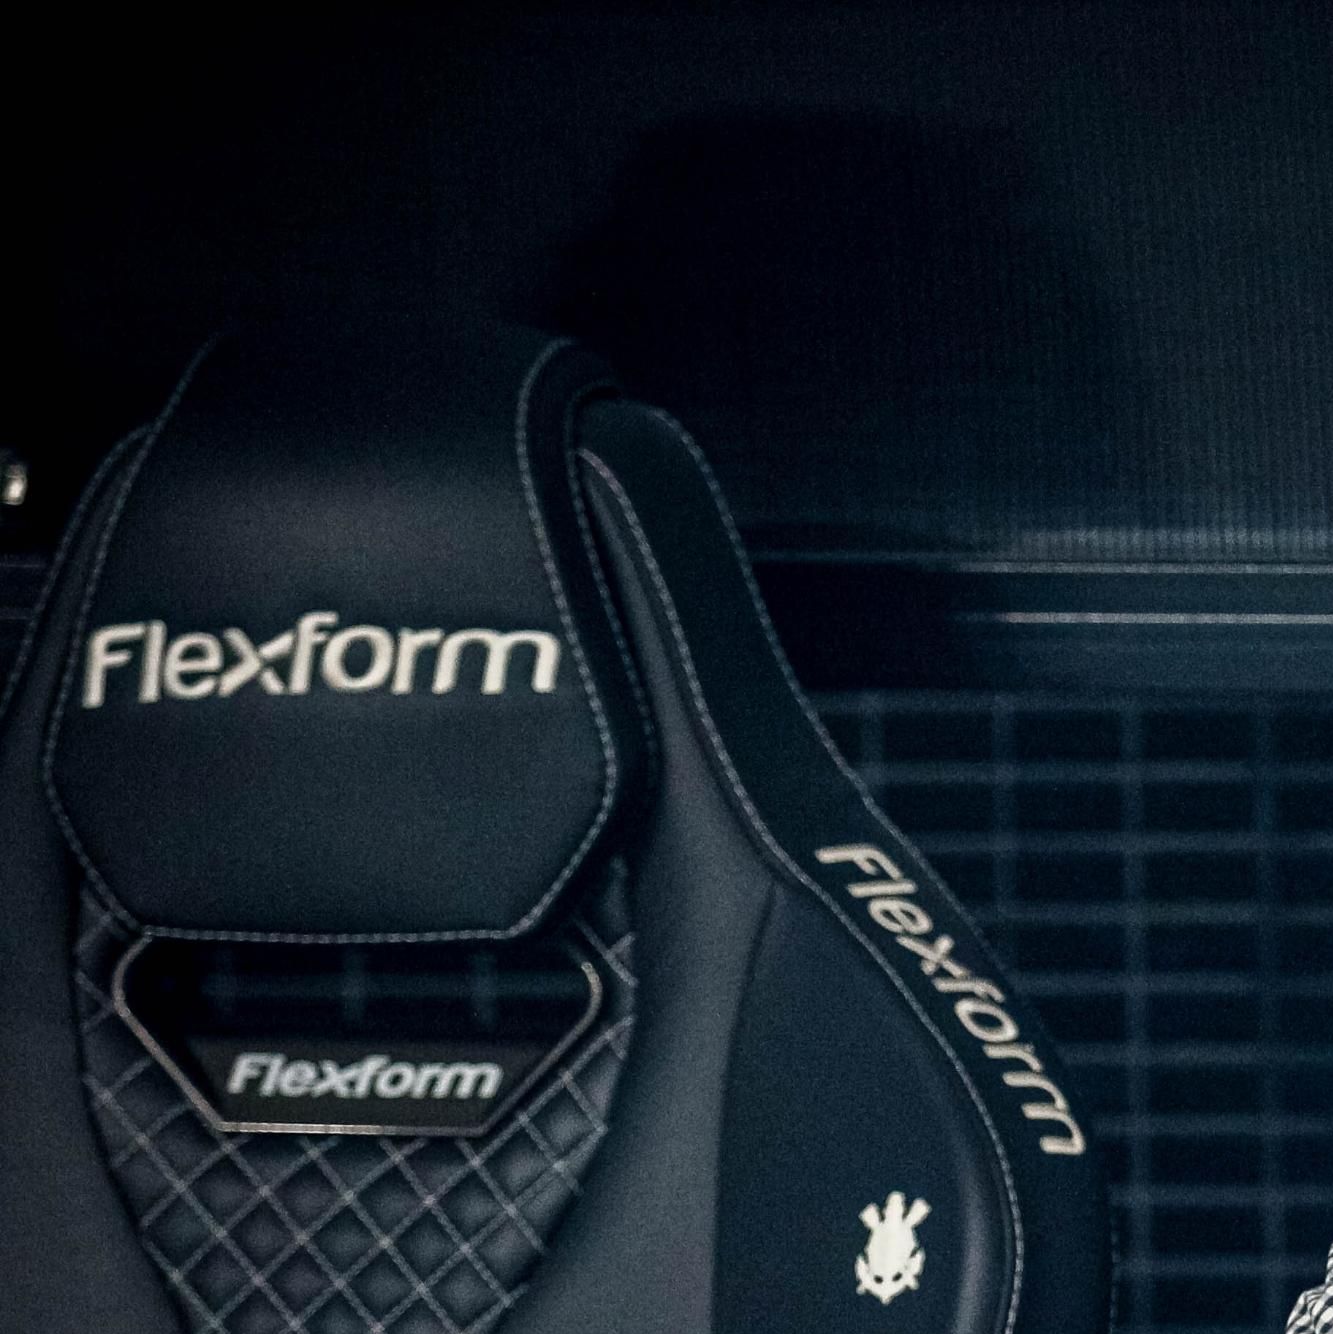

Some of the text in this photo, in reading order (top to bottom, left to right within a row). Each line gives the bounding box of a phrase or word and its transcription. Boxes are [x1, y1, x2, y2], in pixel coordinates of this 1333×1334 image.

[82, 611, 561, 709] Flexform
[814, 843, 1087, 1156] Flexform
[226, 1052, 503, 1099] Flexform
